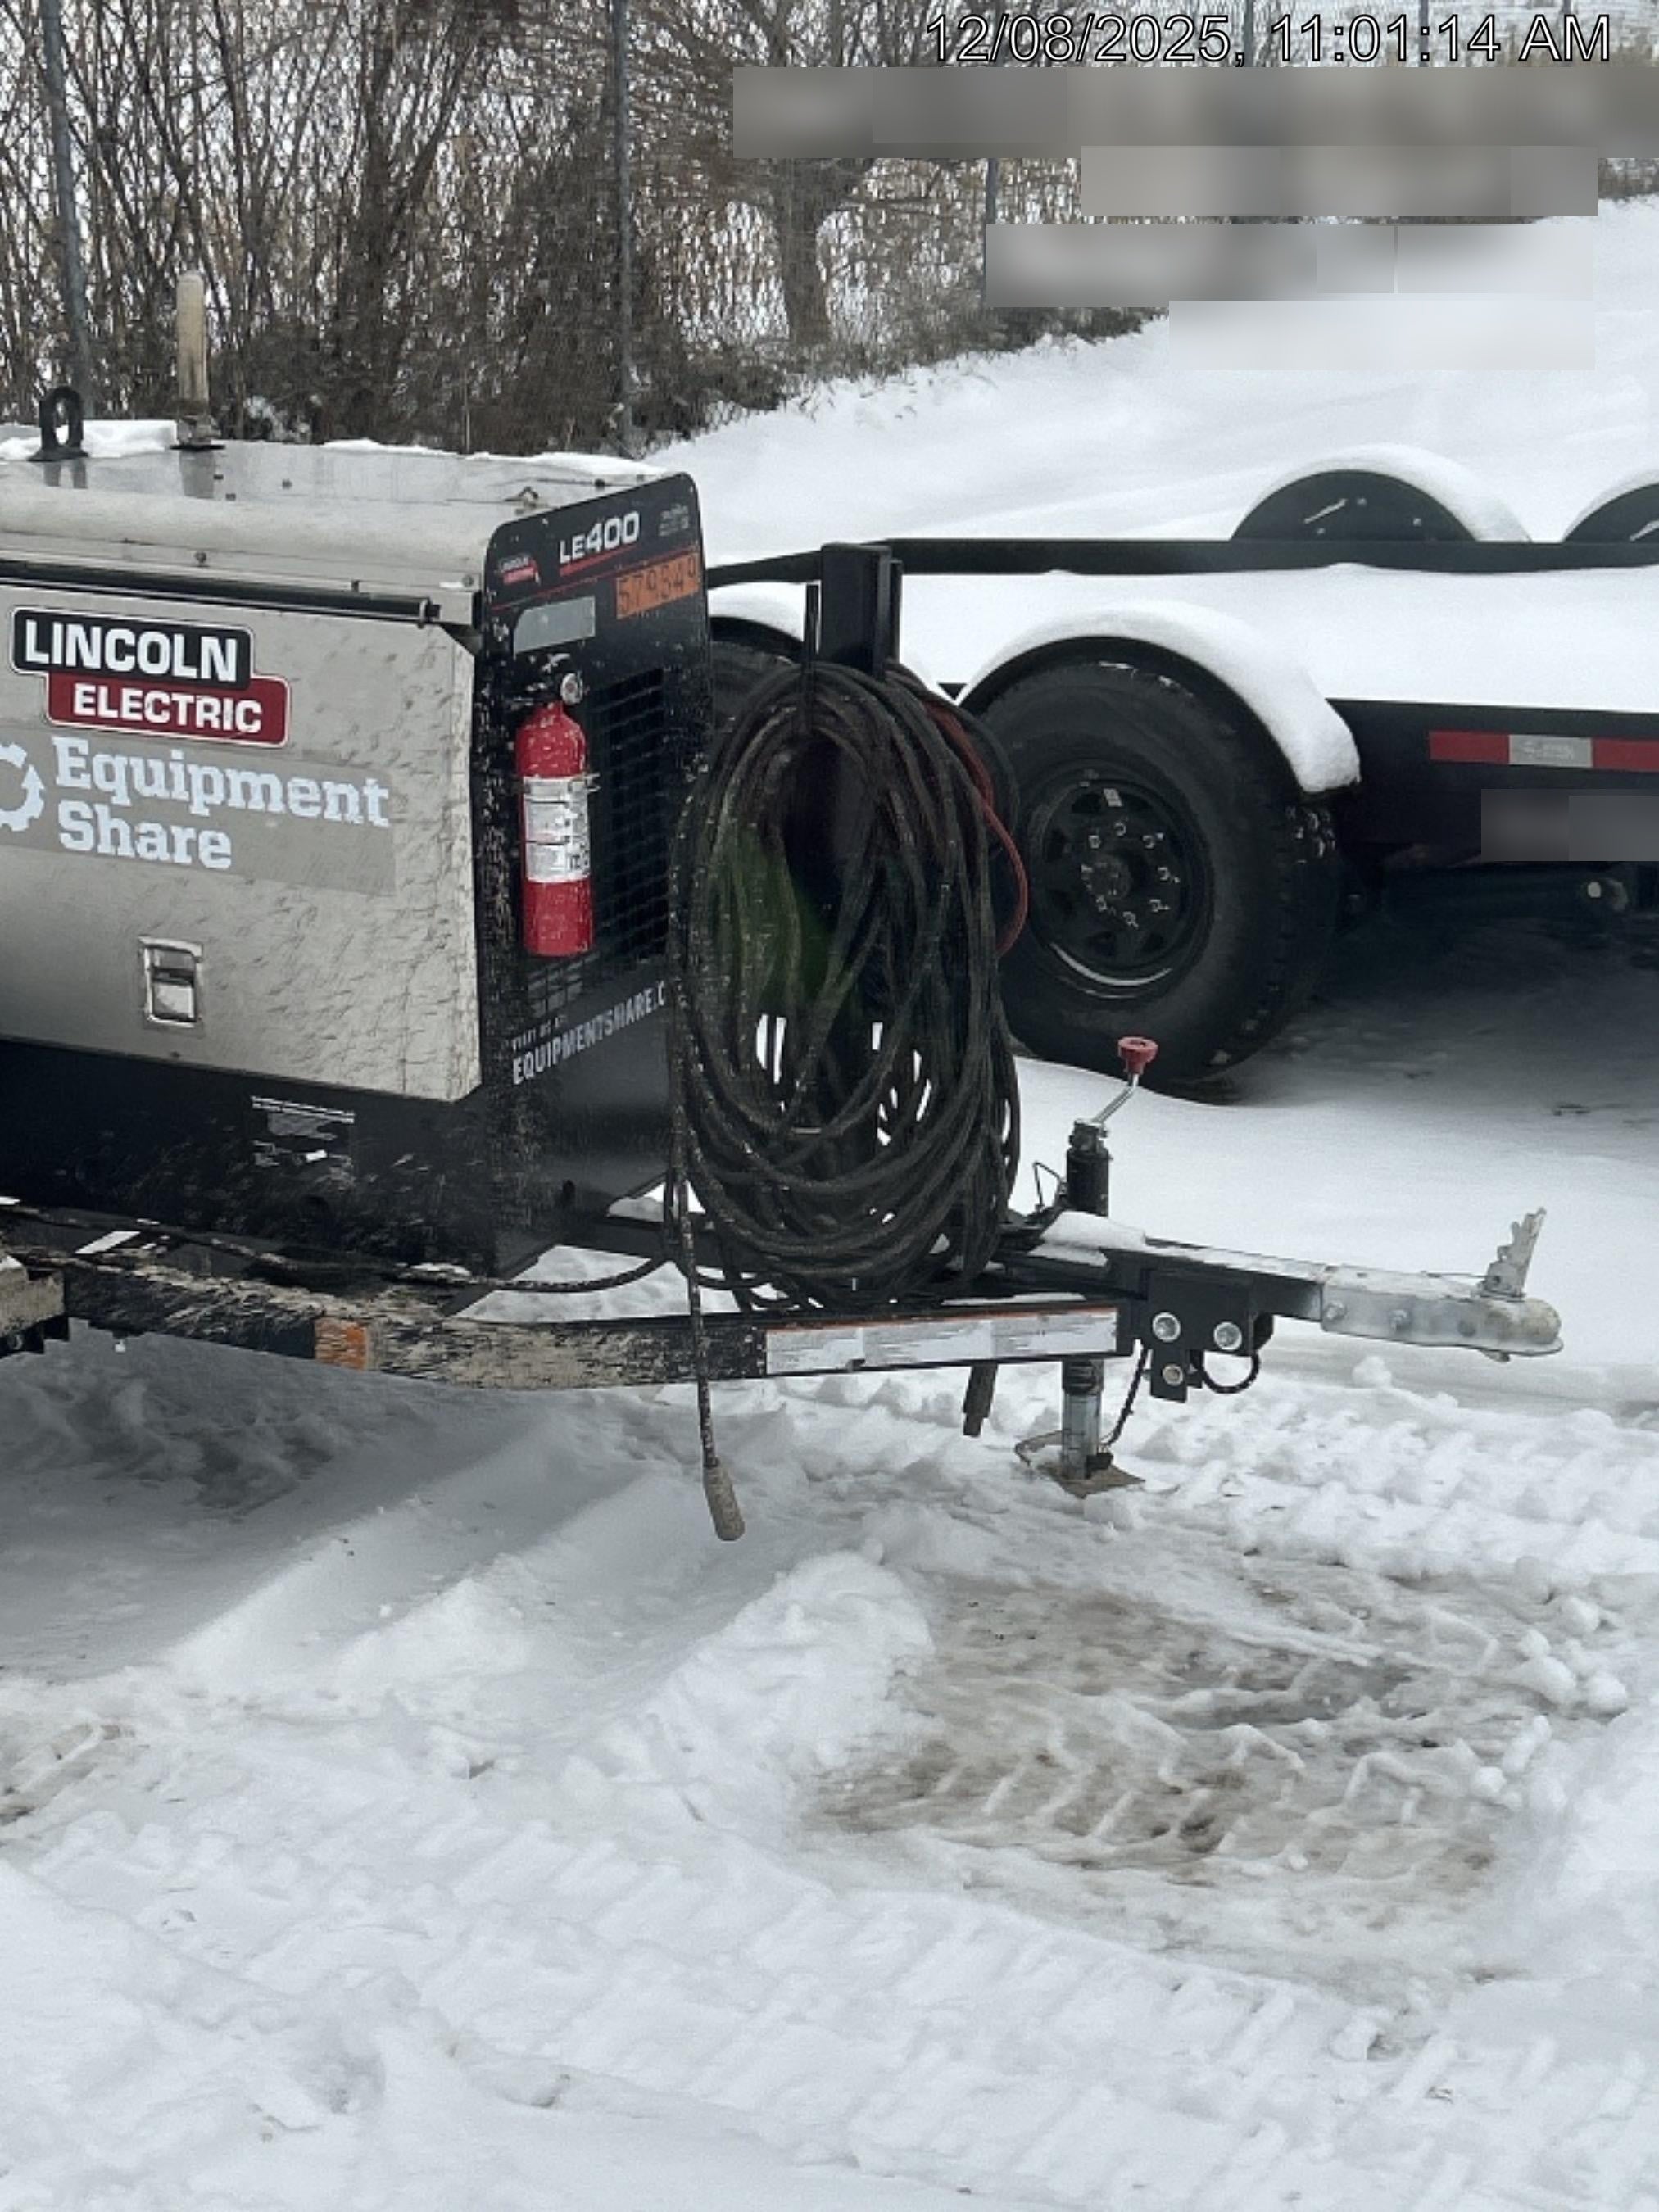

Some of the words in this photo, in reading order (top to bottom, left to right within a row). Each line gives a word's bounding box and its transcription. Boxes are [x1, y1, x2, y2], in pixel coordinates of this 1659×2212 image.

[559, 511, 640, 564] LE400
[25, 619, 238, 682] LINCOLN
[72, 682, 263, 733] ELECTRIC
[51, 736, 391, 828] Equipment
[57, 799, 233, 870] Share
